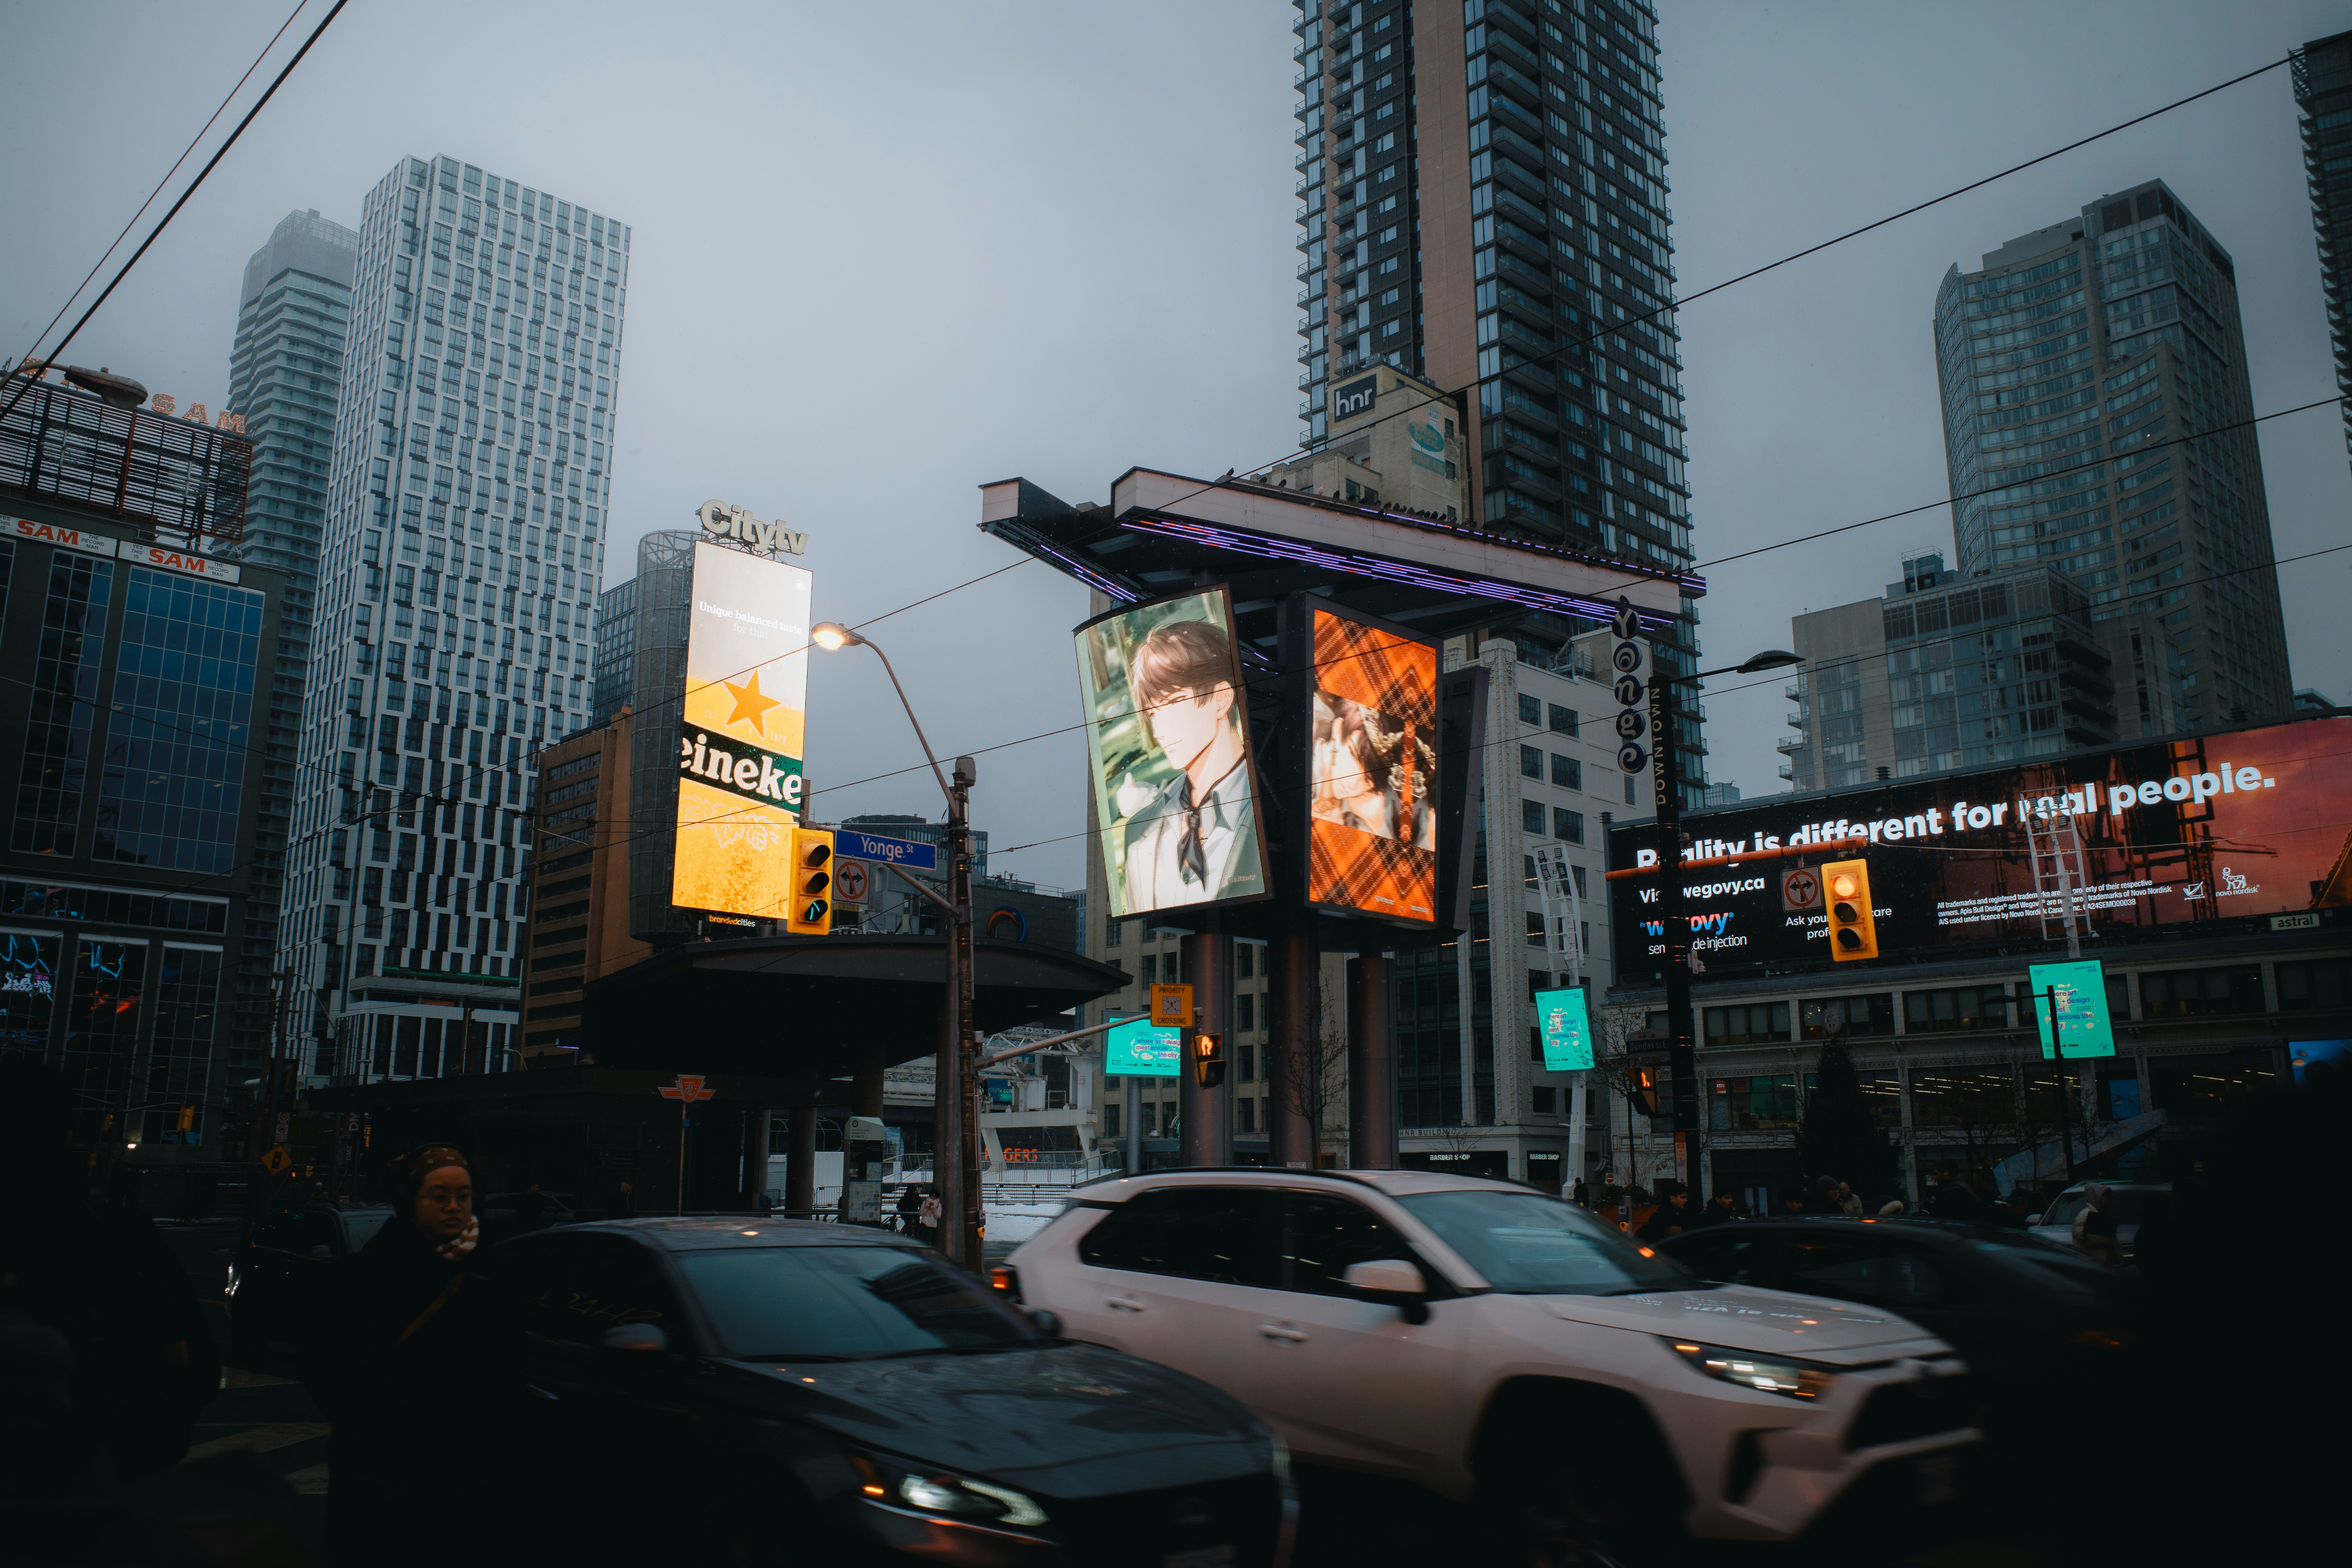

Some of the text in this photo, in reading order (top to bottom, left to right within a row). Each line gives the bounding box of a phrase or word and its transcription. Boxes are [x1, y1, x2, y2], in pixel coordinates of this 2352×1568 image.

[1336, 388, 1372, 417] hnr
[151, 393, 246, 435] SAM
[17, 520, 78, 545] SAM
[701, 499, 809, 555] Citytv
[149, 549, 205, 572] SAM
[700, 601, 802, 635] Unique balanced taste
[733, 622, 769, 639] for that
[1651, 688, 1666, 805] DOWNTOWN
[1637, 839, 1746, 867] Rality
[1789, 808, 1943, 844] different
[1952, 802, 2007, 831] for
[2019, 782, 2097, 822] real
[2110, 762, 2275, 815] people.
[861, 836, 913, 861] Yonge St
[1683, 877, 1765, 898] wegovy.ca
[2073, 886, 2097, 895] proerty
[2105, 882, 2120, 890] their
[2121, 879, 2152, 889] respective
[1945, 898, 1976, 909] trademarks
[1988, 894, 2016, 904] registered
[2017, 891, 2051, 900] trademrks
[1960, 907, 1972, 916] Apis
[1973, 905, 1984, 913] Bull
[2088, 891, 2122, 901] trademarks
[2147, 885, 2172, 895] Nordisk
[709, 915, 756, 927] brandedcities
[1786, 916, 1805, 926] Ask
[1964, 915, 1980, 923] under
[1980, 913, 2001, 922] licence
[2025, 908, 2047, 916] Nordik
[2278, 915, 2313, 928] astral
[1707, 934, 1747, 951] injection
[1630, 1042, 1654, 1051] Dundas
[349, 1112, 359, 1131] DM
[984, 1147, 1038, 1162] RGERS
